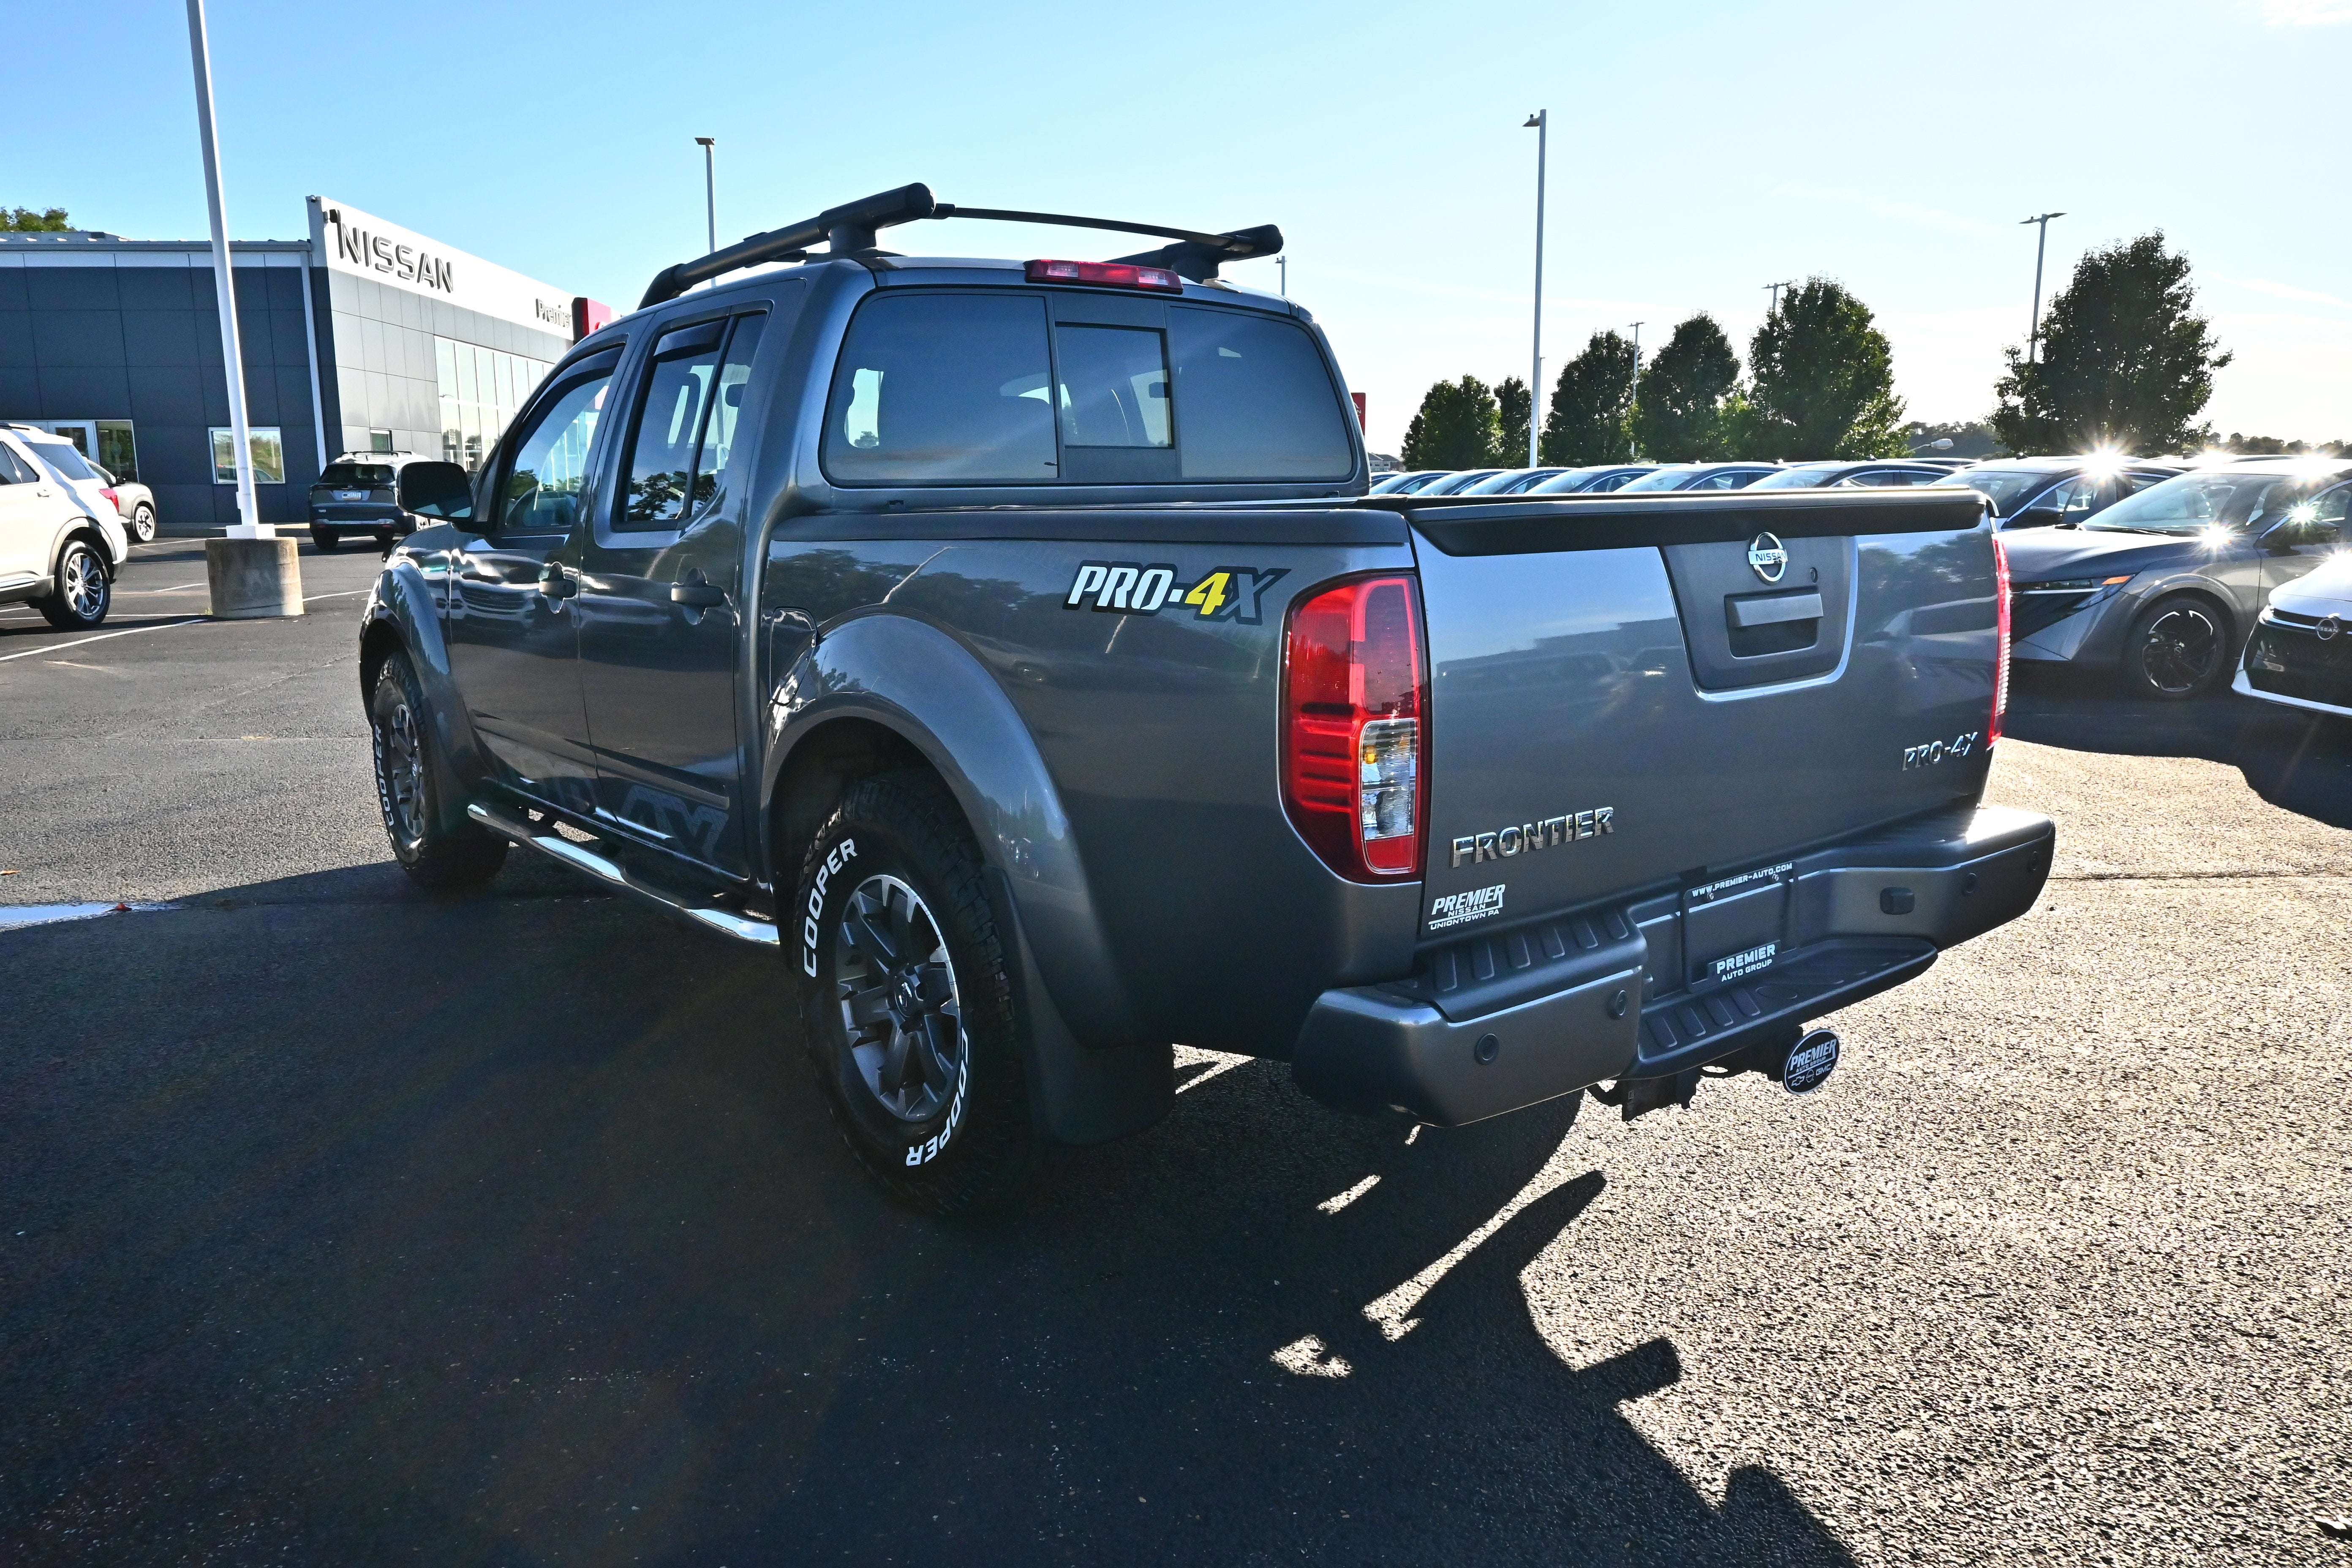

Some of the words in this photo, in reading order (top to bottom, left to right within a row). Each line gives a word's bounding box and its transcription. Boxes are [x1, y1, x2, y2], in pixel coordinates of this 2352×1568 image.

[337, 223, 454, 293] NISSAN
[536, 298, 572, 328] Premier
[1755, 552, 1787, 561] NISSAN
[1064, 562, 1285, 623] PRO-4X
[1902, 732, 1978, 771] PRO-4X
[375, 723, 395, 827] COOPER
[1450, 806, 1615, 868] FRONTIER
[1692, 863, 1792, 897] WWW.PREMIER-AUTO.COM
[803, 838, 858, 978] COOPER
[1431, 884, 1506, 915] PREMIER
[1448, 903, 1486, 917] NISSAN
[1430, 911, 1486, 930] UNIONTOWN
[1488, 909, 1500, 917] PA
[1717, 944, 1775, 974] PREMIER
[1721, 969, 1743, 982] AUTO
[1745, 958, 1772, 973] GROUP
[1789, 1039, 1837, 1071] PREMIER
[1796, 1064, 1809, 1073] AUTO
[1810, 1056, 1827, 1066] GROUP
[1816, 1063, 1832, 1076] GMC
[905, 1026, 969, 1167] COOPER
